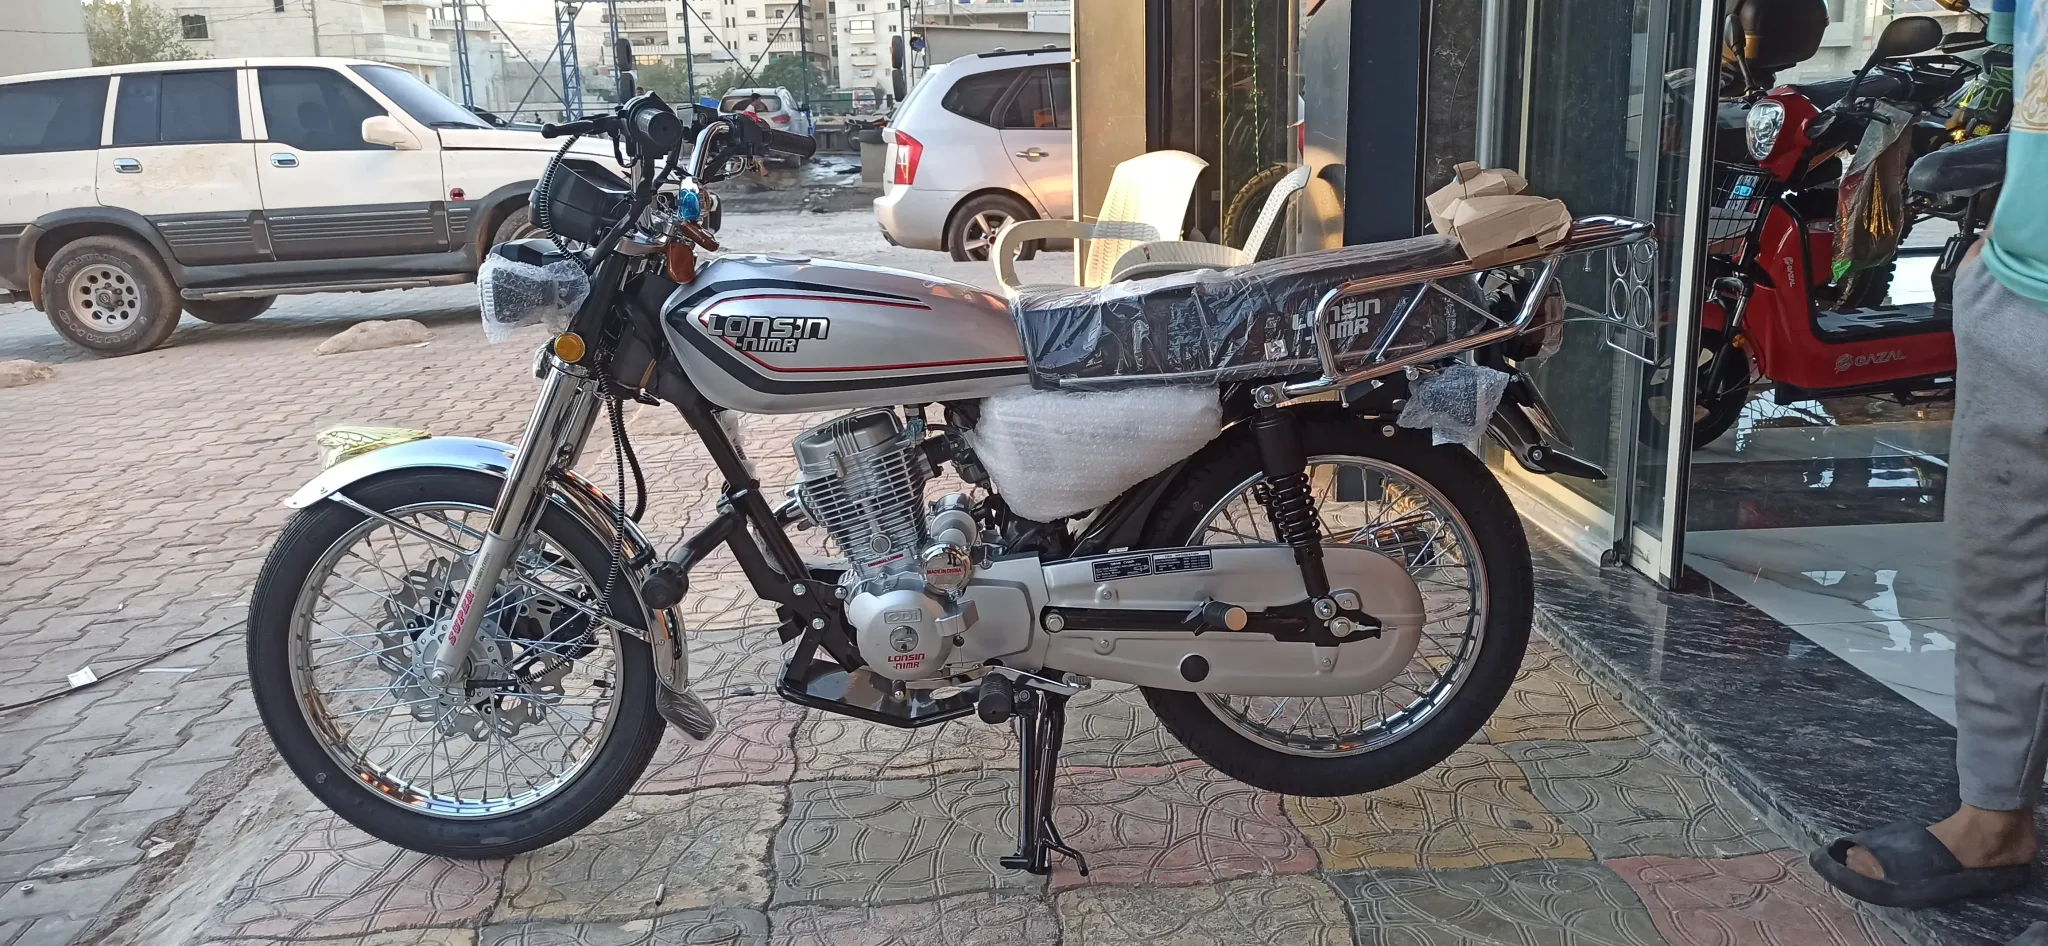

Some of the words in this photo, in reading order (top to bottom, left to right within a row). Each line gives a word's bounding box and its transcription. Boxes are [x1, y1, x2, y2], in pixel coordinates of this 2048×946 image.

[58, 309, 137, 343] KUMHO
[707, 314, 831, 339] LONSIN
[1854, 350, 1906, 367] GAZAL
[449, 589, 474, 646] SUPER
[887, 611, 918, 621] CDI
[887, 653, 925, 663] LONSIN
